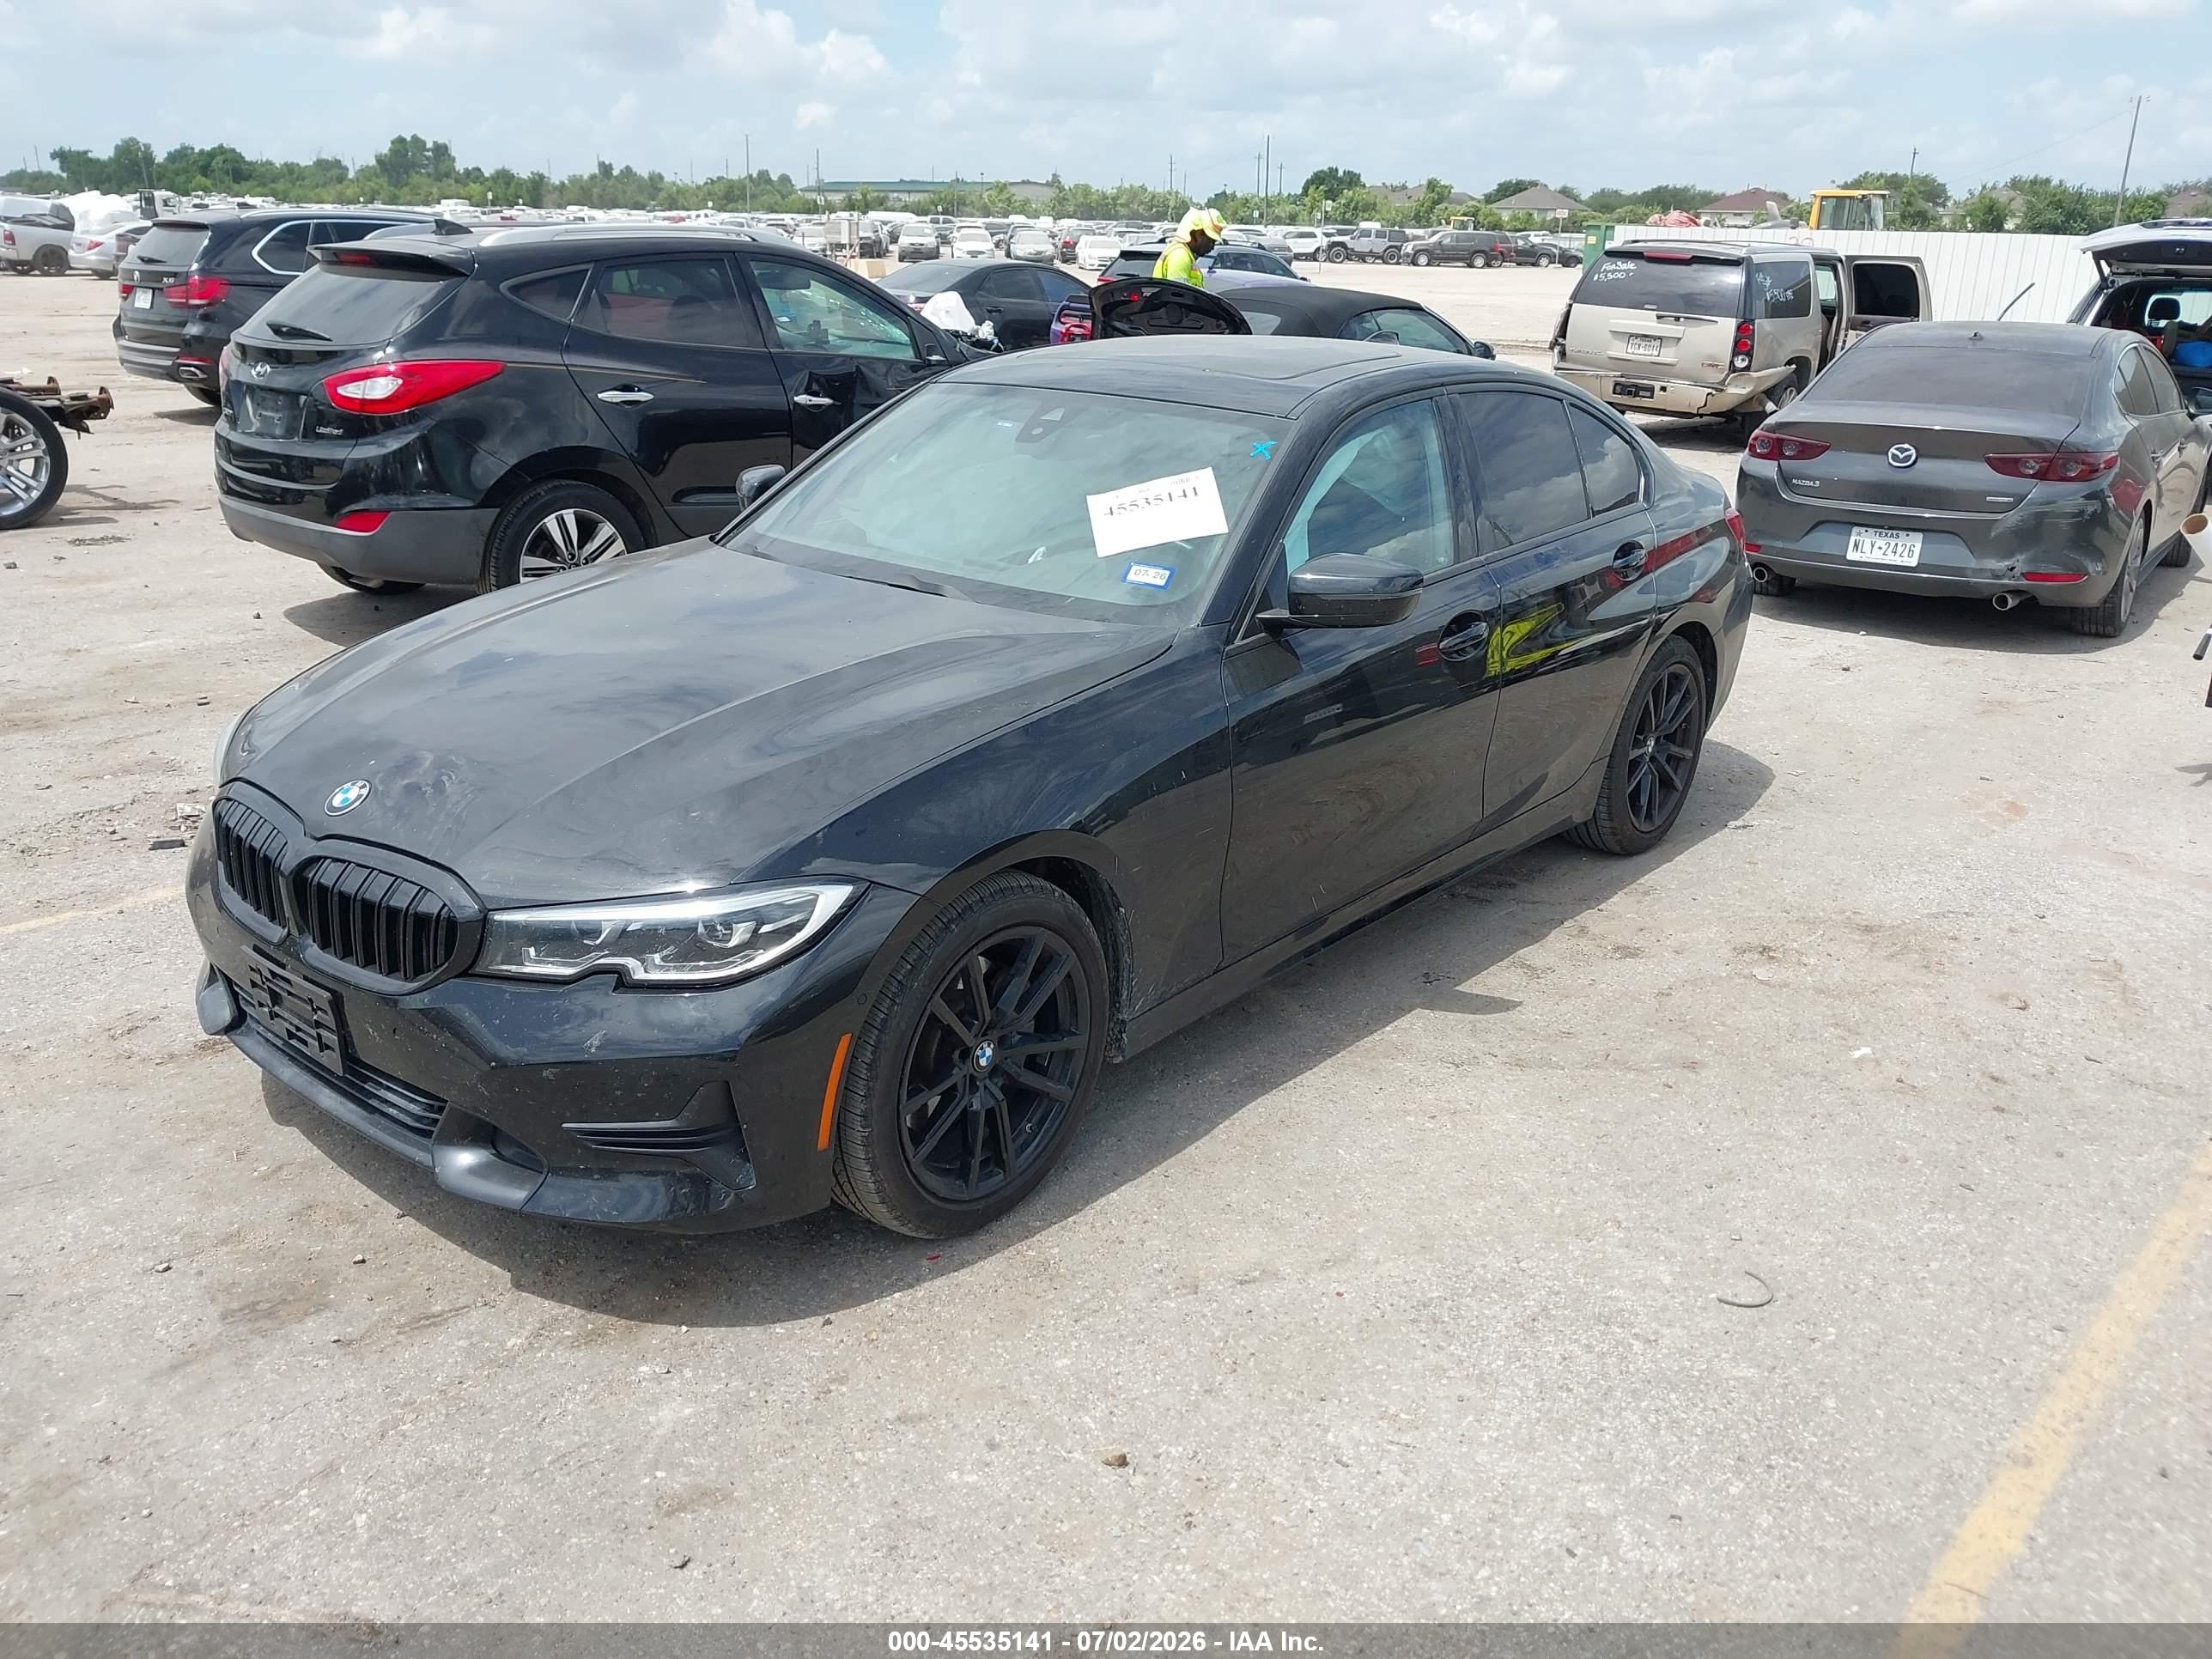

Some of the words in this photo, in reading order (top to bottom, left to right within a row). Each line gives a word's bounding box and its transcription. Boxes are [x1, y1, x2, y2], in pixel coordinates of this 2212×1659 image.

[1600, 262, 1616, 272] For
[1616, 261, 1637, 270] Sale
[1873, 530, 1900, 540] TEXAS
